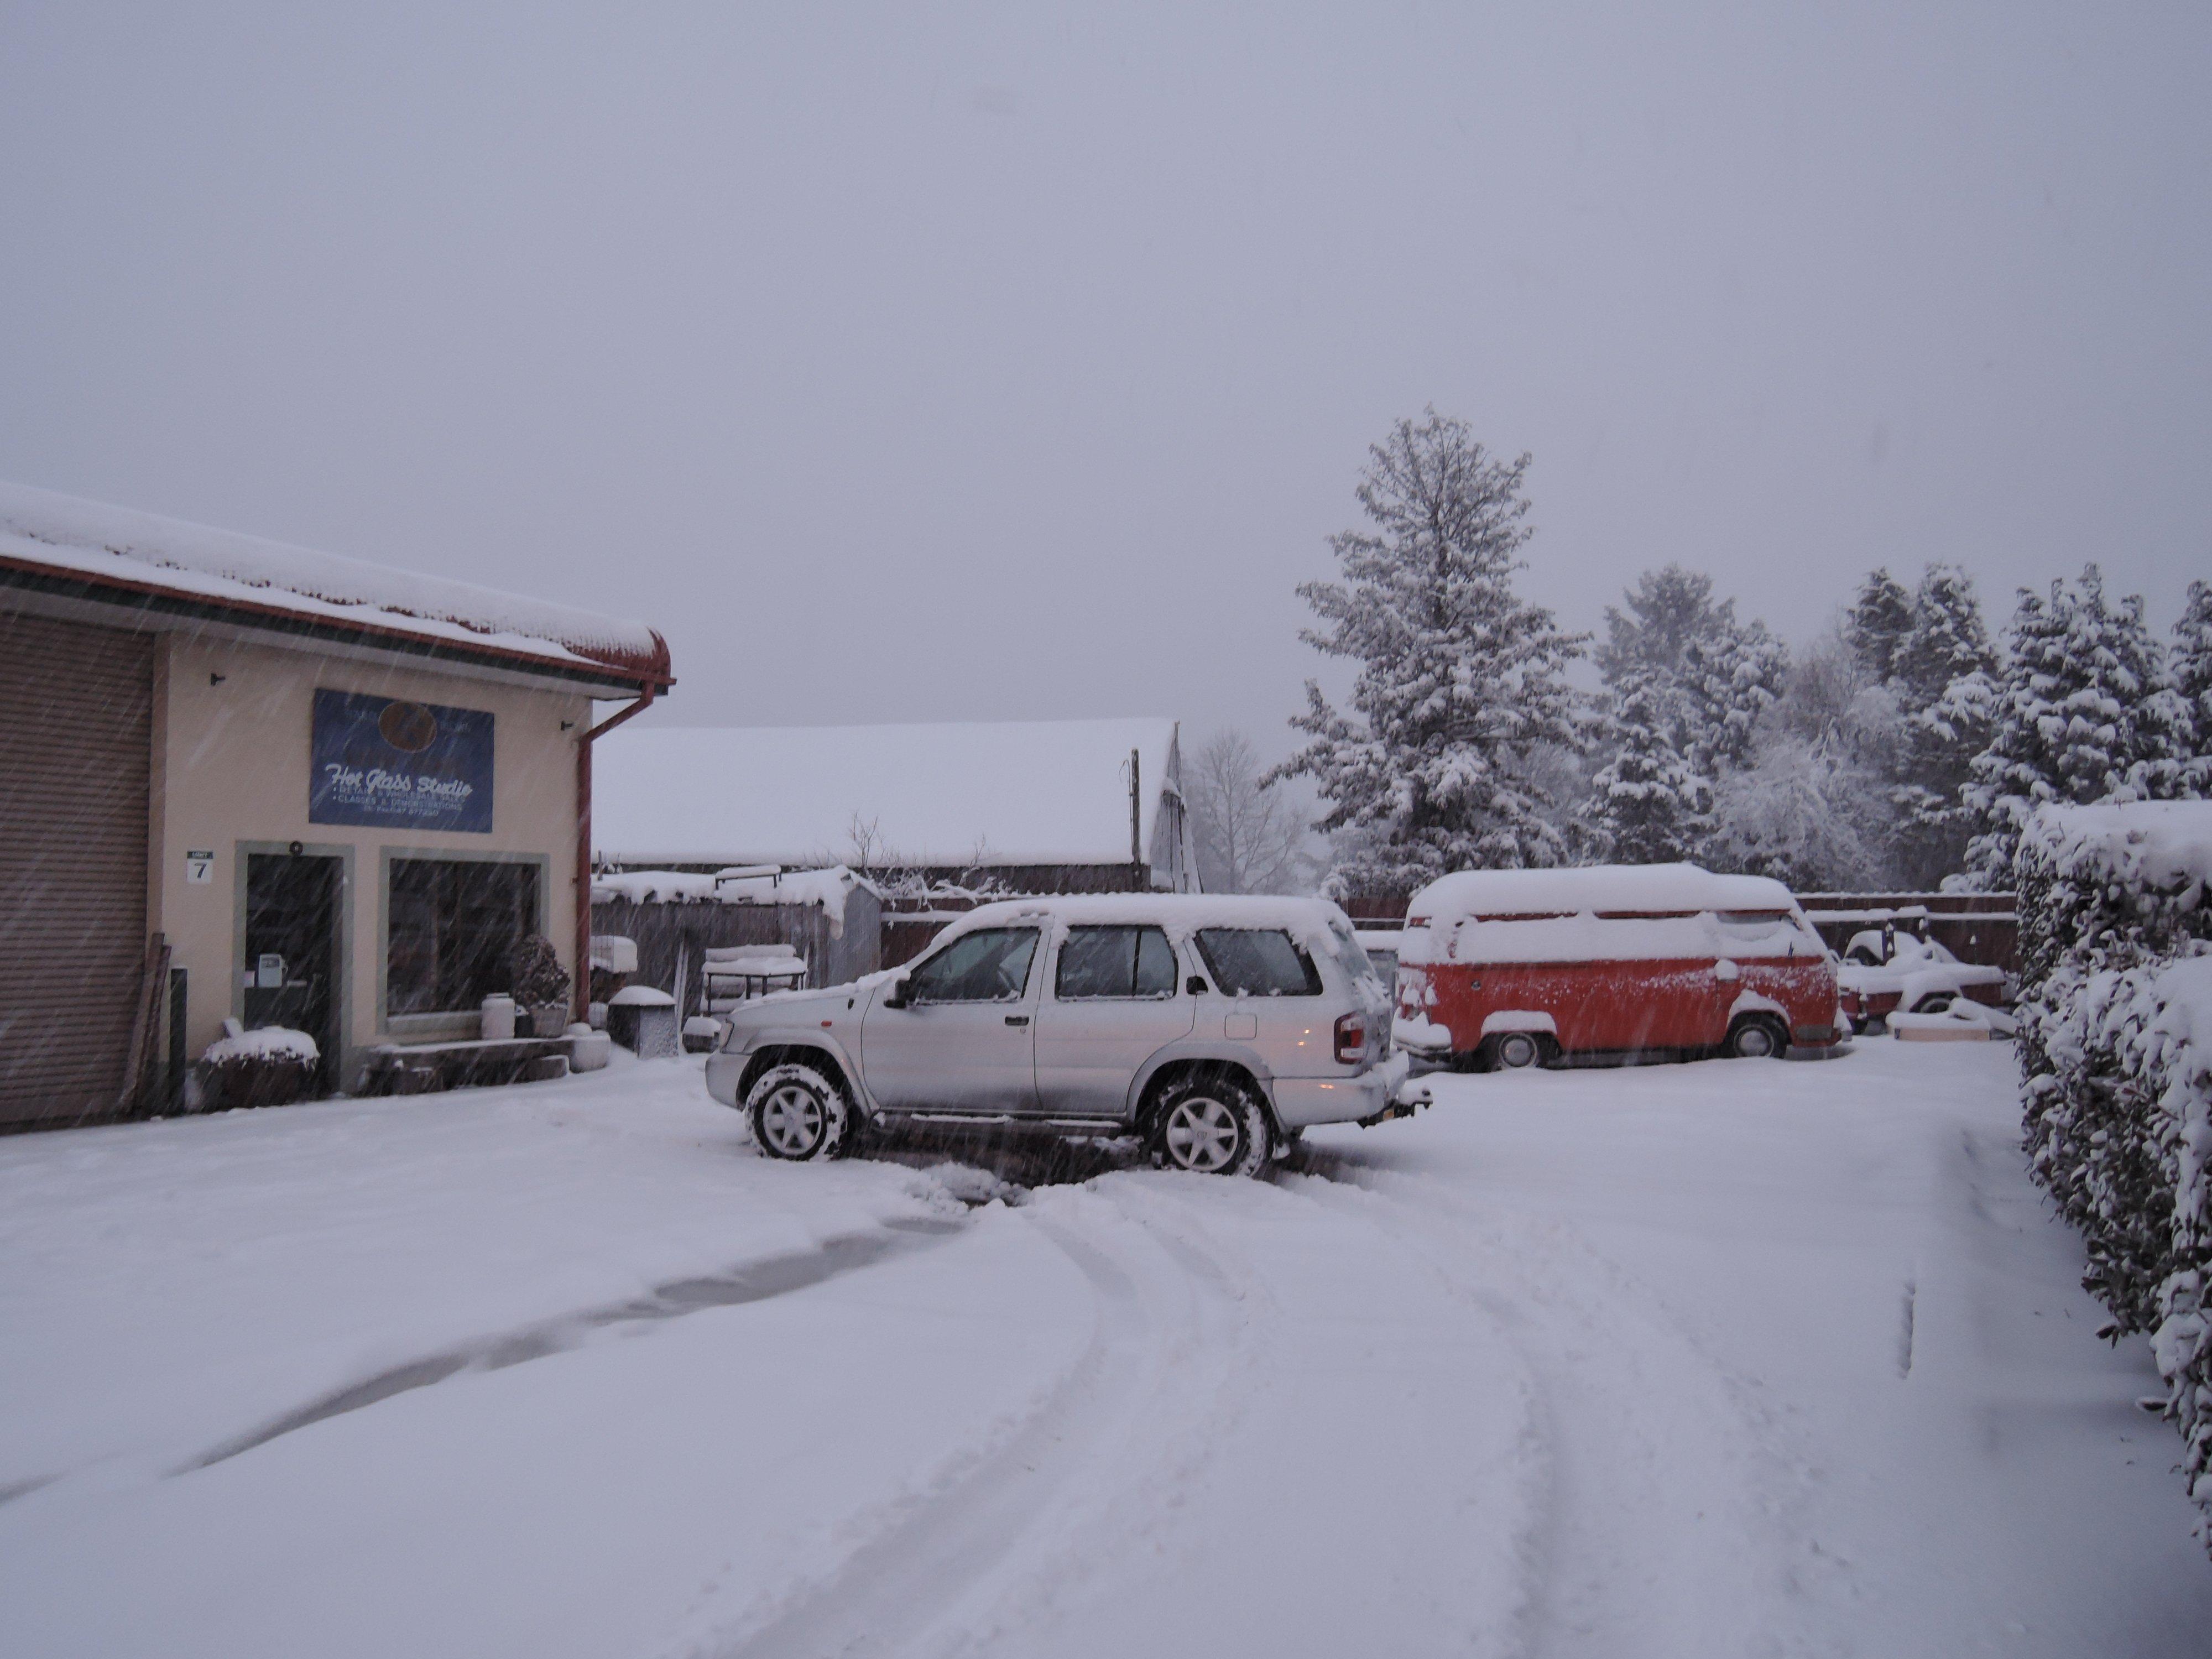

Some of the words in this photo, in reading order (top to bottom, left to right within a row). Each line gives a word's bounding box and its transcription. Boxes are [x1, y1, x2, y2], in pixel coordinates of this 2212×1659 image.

[366, 768, 411, 795] Glass
[416, 776, 473, 797] Studio
[194, 863, 207, 878] 7
